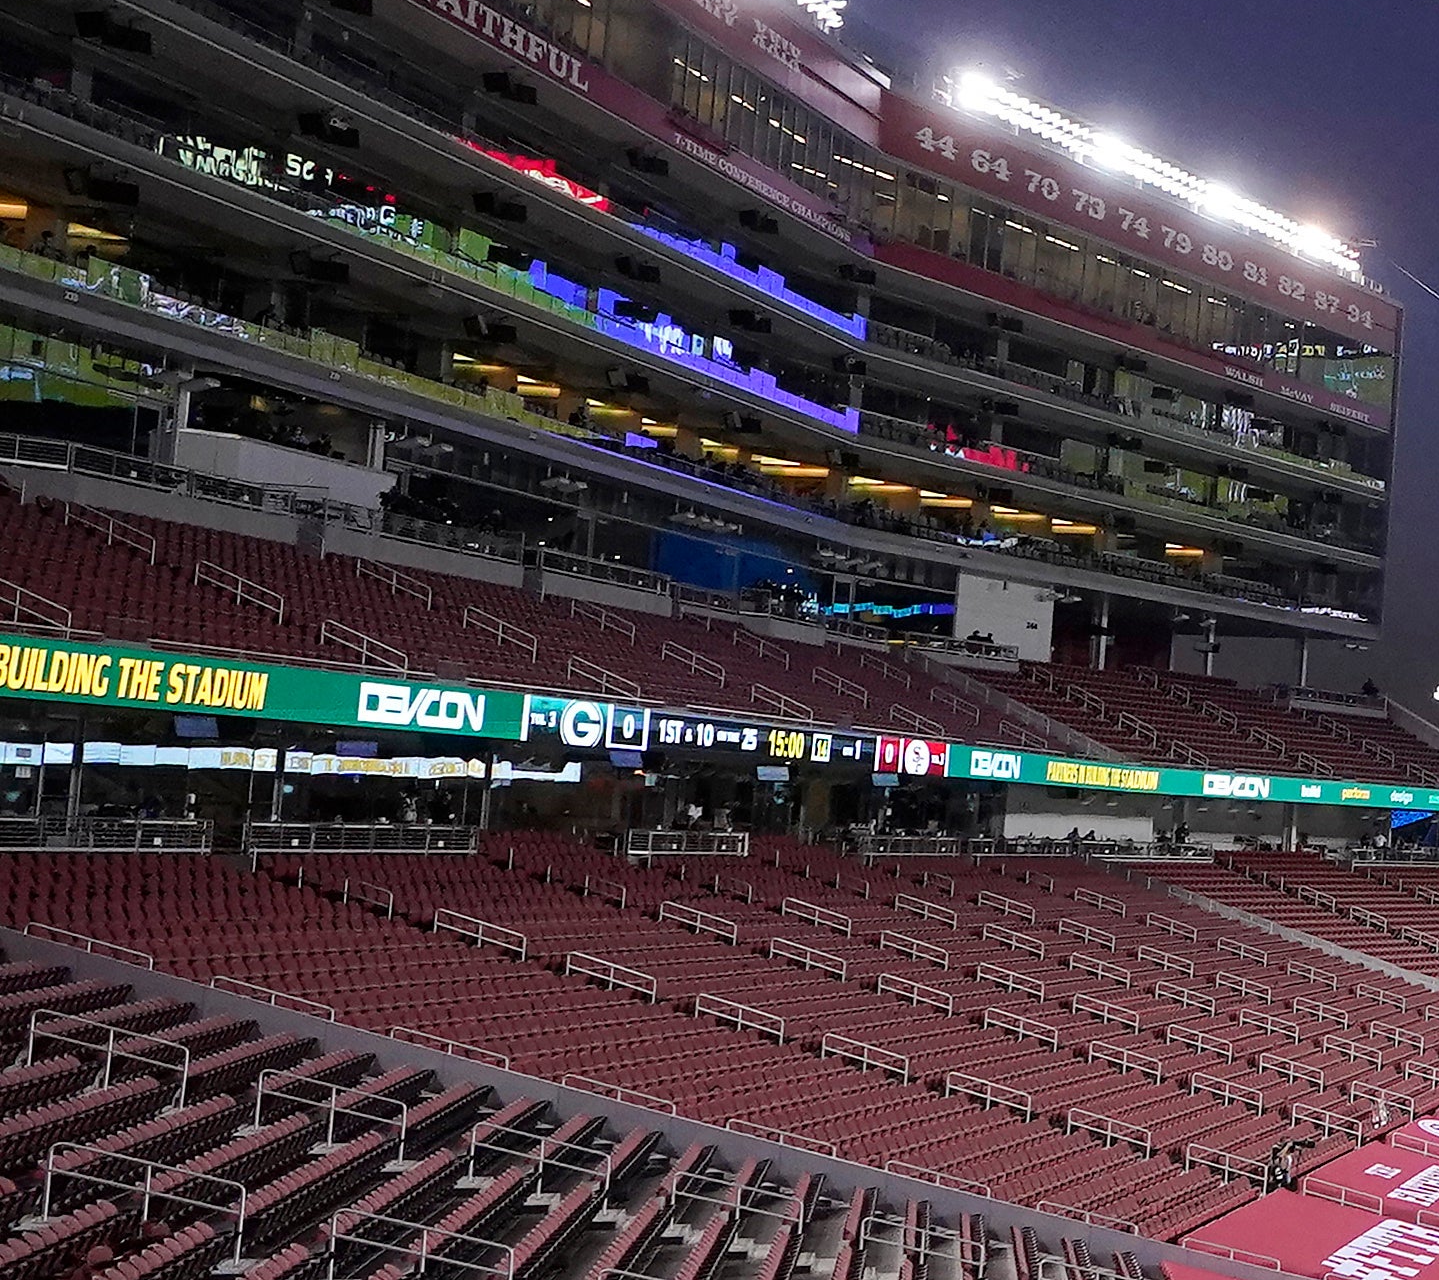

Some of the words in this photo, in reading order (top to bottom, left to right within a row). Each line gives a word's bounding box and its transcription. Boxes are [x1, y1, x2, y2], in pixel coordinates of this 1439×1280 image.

[717, 157, 790, 208] CONFERENCE
[790, 199, 852, 243] CHAMPIONS
[970, 148, 1013, 184] 64
[1023, 169, 1061, 201] 70
[1071, 187, 1107, 221] 73
[1117, 207, 1150, 240] 74
[1161, 224, 1194, 255] 79
[1224, 366, 1264, 386] WALSH
[117, 656, 164, 703] THE
[165, 662, 270, 712] STADIUM
[357, 681, 487, 731] DEVCON
[562, 701, 602, 747] G
[622, 713, 635, 740] 0
[659, 719, 684, 744] 1ST
[696, 723, 714, 746] 10
[741, 726, 759, 752] 25
[767, 730, 805, 760] 15:00
[884, 742, 894, 765] 0
[969, 750, 1022, 780] DEVCON
[1121, 767, 1159, 791] STADIUM
[1202, 774, 1270, 799] DEVCON
